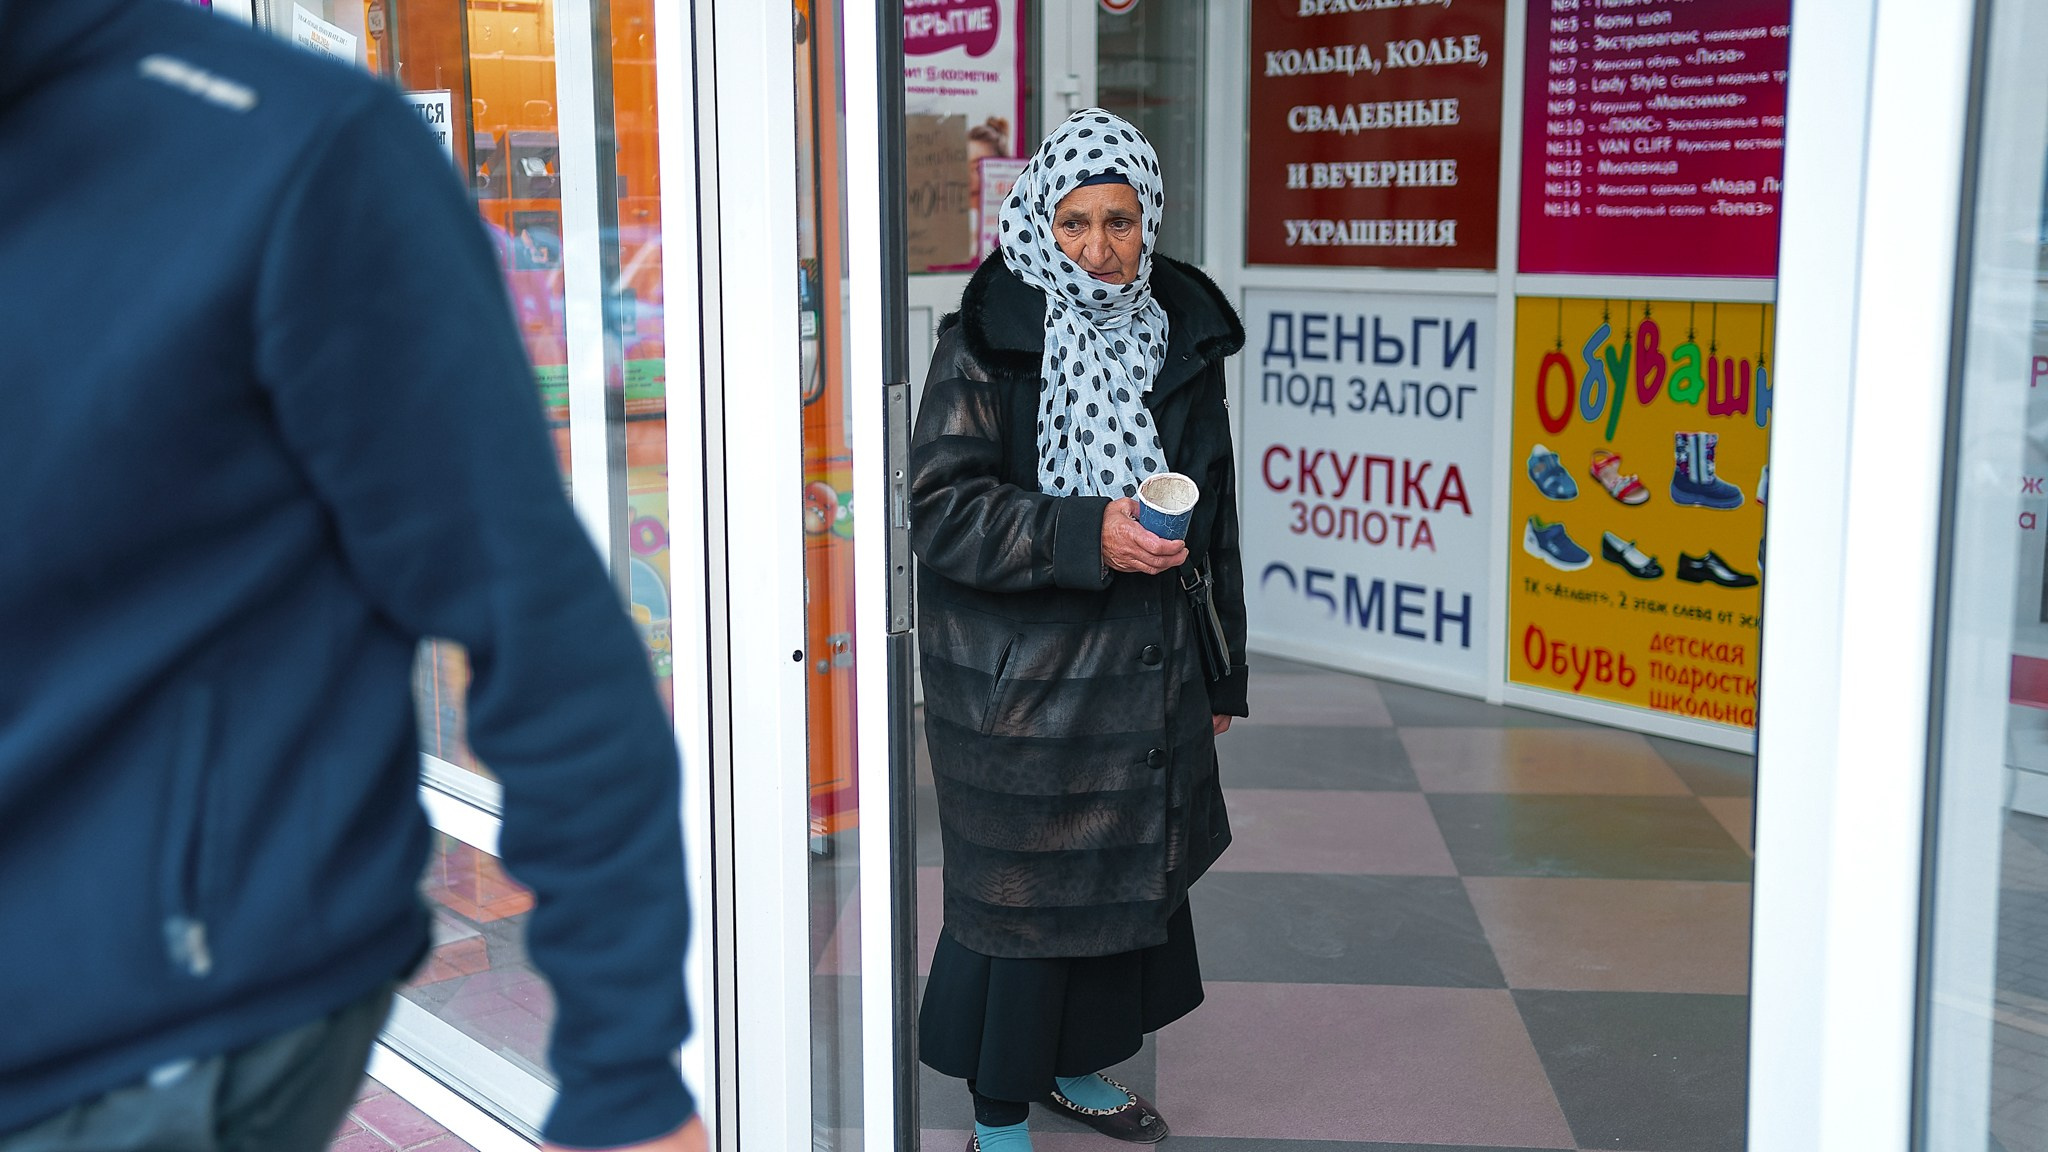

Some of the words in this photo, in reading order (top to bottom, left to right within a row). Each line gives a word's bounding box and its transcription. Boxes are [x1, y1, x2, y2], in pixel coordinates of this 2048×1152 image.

[1550, 16, 1579, 33] №5
[1593, 13, 1634, 30] Копи
[1636, 10, 1672, 26] шоп
[1264, 43, 1382, 78] КОЛЬЦА,
[1385, 34, 1489, 68] КОЛЬЕ,
[1549, 36, 1578, 54] №6
[1549, 57, 1577, 74] №7
[1548, 78, 1577, 95] №8
[1591, 75, 1628, 95] Lady
[1630, 72, 1667, 93] Style
[1287, 98, 1460, 136] СВАДЕБНЫЕ
[1547, 99, 1576, 115] №9
[1547, 119, 1585, 136] №10
[1546, 140, 1583, 156] №11
[1597, 138, 1630, 154] VAN
[1633, 136, 1673, 153] CLIFF
[1286, 163, 1308, 189] И
[1310, 159, 1459, 189] ВЕЧЕРНИЕ
[1545, 160, 1582, 177] №12
[1545, 180, 1581, 197] №13
[1544, 201, 1581, 218] №14
[1283, 219, 1458, 247] УКРАШЕНИЯ
[1262, 311, 1478, 371] ДЕНЬГИ
[1262, 371, 1336, 417] ПОД
[1347, 377, 1478, 421] ЗАЛОГ
[1262, 444, 1473, 517] СКУПКА
[1289, 501, 1436, 552] ЗОЛОТА
[1618, 591, 1628, 609] 2
[1649, 689, 1758, 730] школьна
